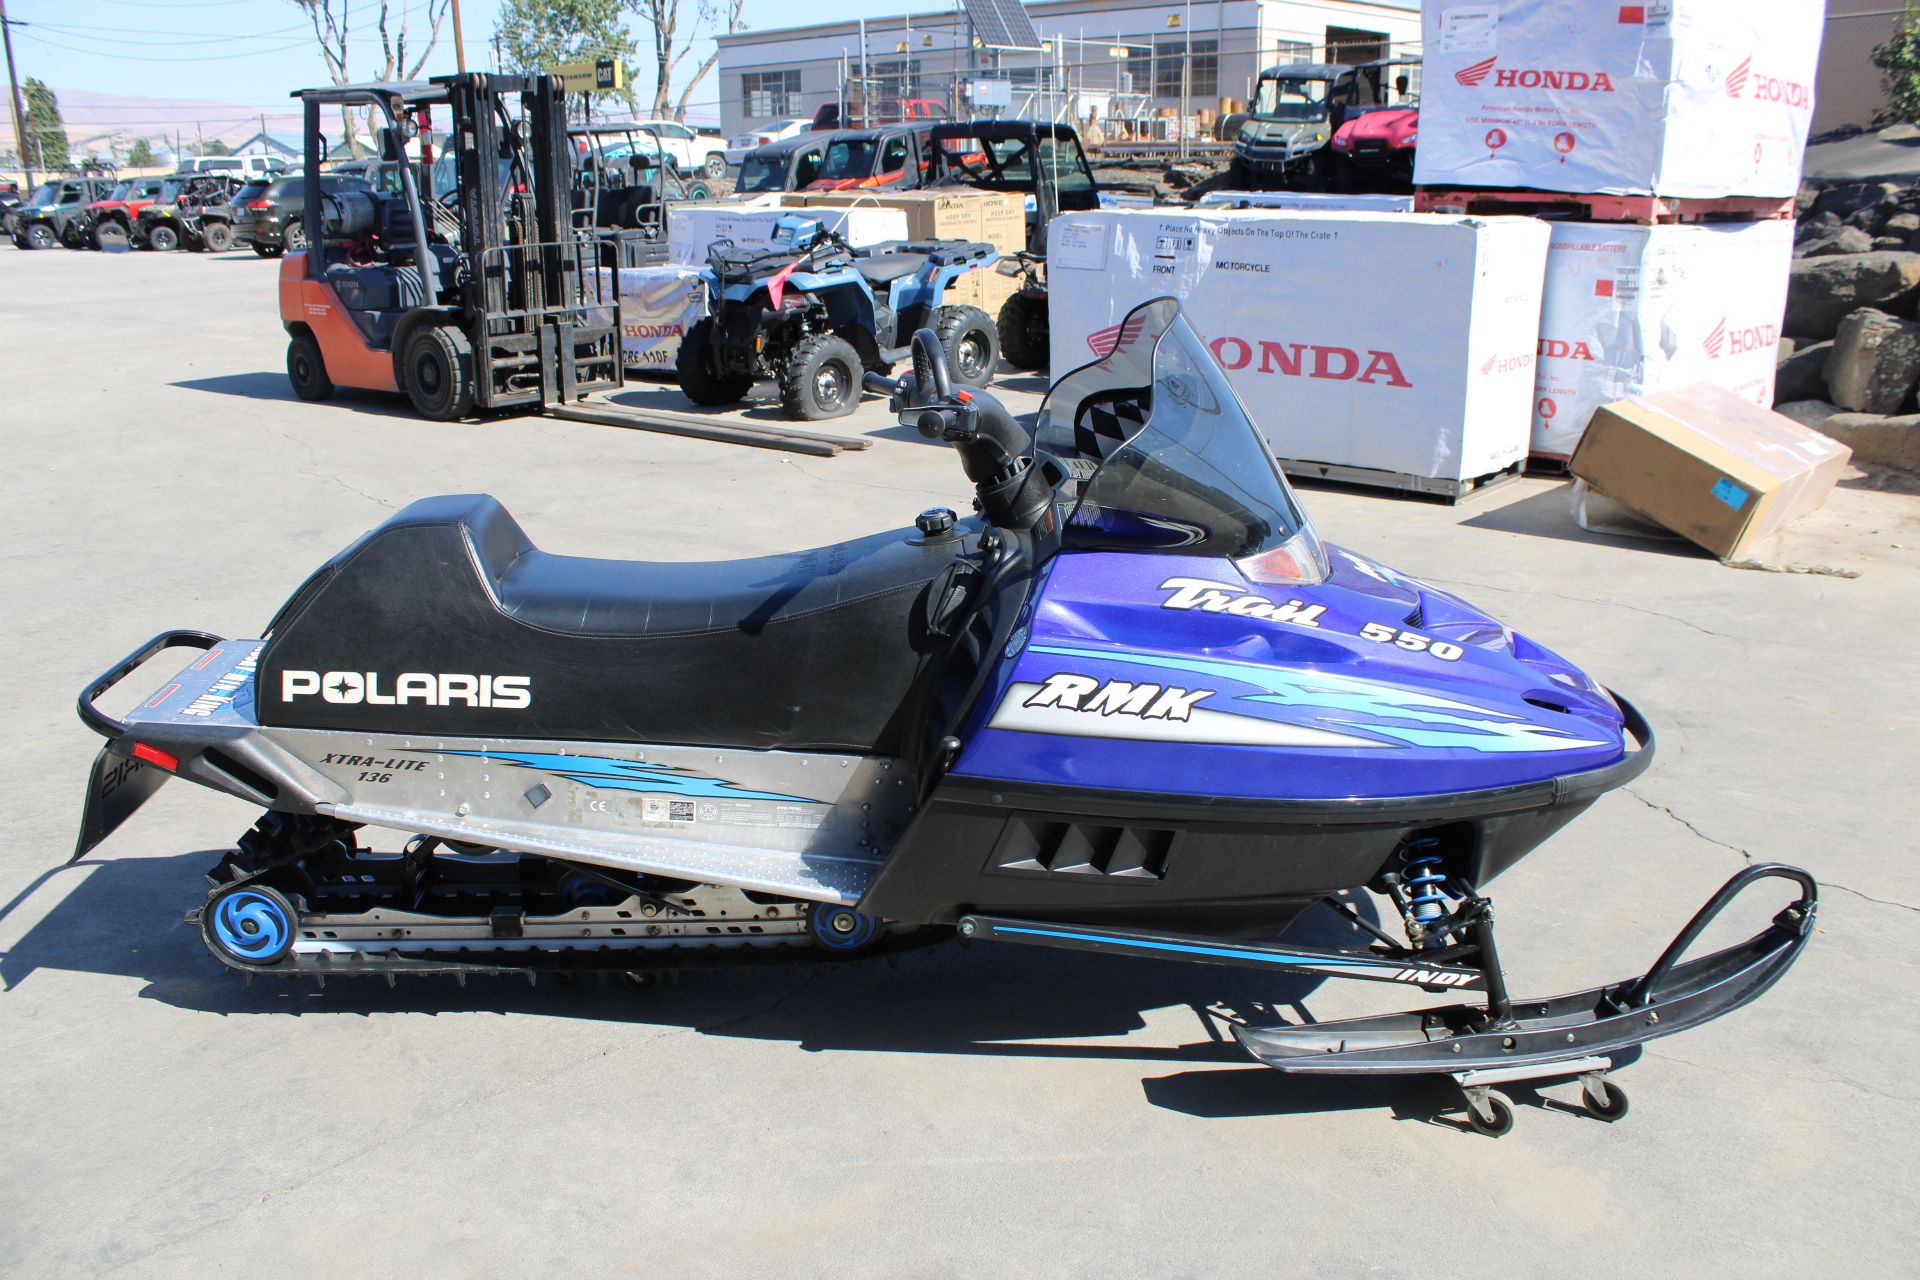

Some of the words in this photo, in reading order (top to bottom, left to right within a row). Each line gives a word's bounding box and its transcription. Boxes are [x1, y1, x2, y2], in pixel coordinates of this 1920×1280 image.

[597, 67, 612, 82] CAT
[1495, 69, 1615, 92] HONDA
[983, 199, 1004, 208] HOND
[1165, 224, 1183, 233] Place
[1217, 226, 1245, 237] Objects
[1245, 228, 1255, 236] On
[1257, 228, 1269, 237] The
[1270, 229, 1284, 239] Top
[1285, 230, 1294, 238] Of
[1295, 230, 1309, 239] The
[1310, 231, 1331, 240] Crate
[1153, 266, 1176, 275] FRONT
[1215, 261, 1271, 273] MOTORCYCLE
[624, 324, 685, 338] HONDA
[1728, 324, 1778, 355] HOND
[1208, 336, 1414, 389] ONDA
[1159, 575, 1328, 629] Trail
[1357, 620, 1466, 663] 550
[281, 669, 532, 710] POLARIS
[1021, 671, 1218, 724] RMK
[318, 751, 431, 774] XTRA-LITE
[356, 771, 394, 785] 136
[1395, 968, 1484, 987] INDY
